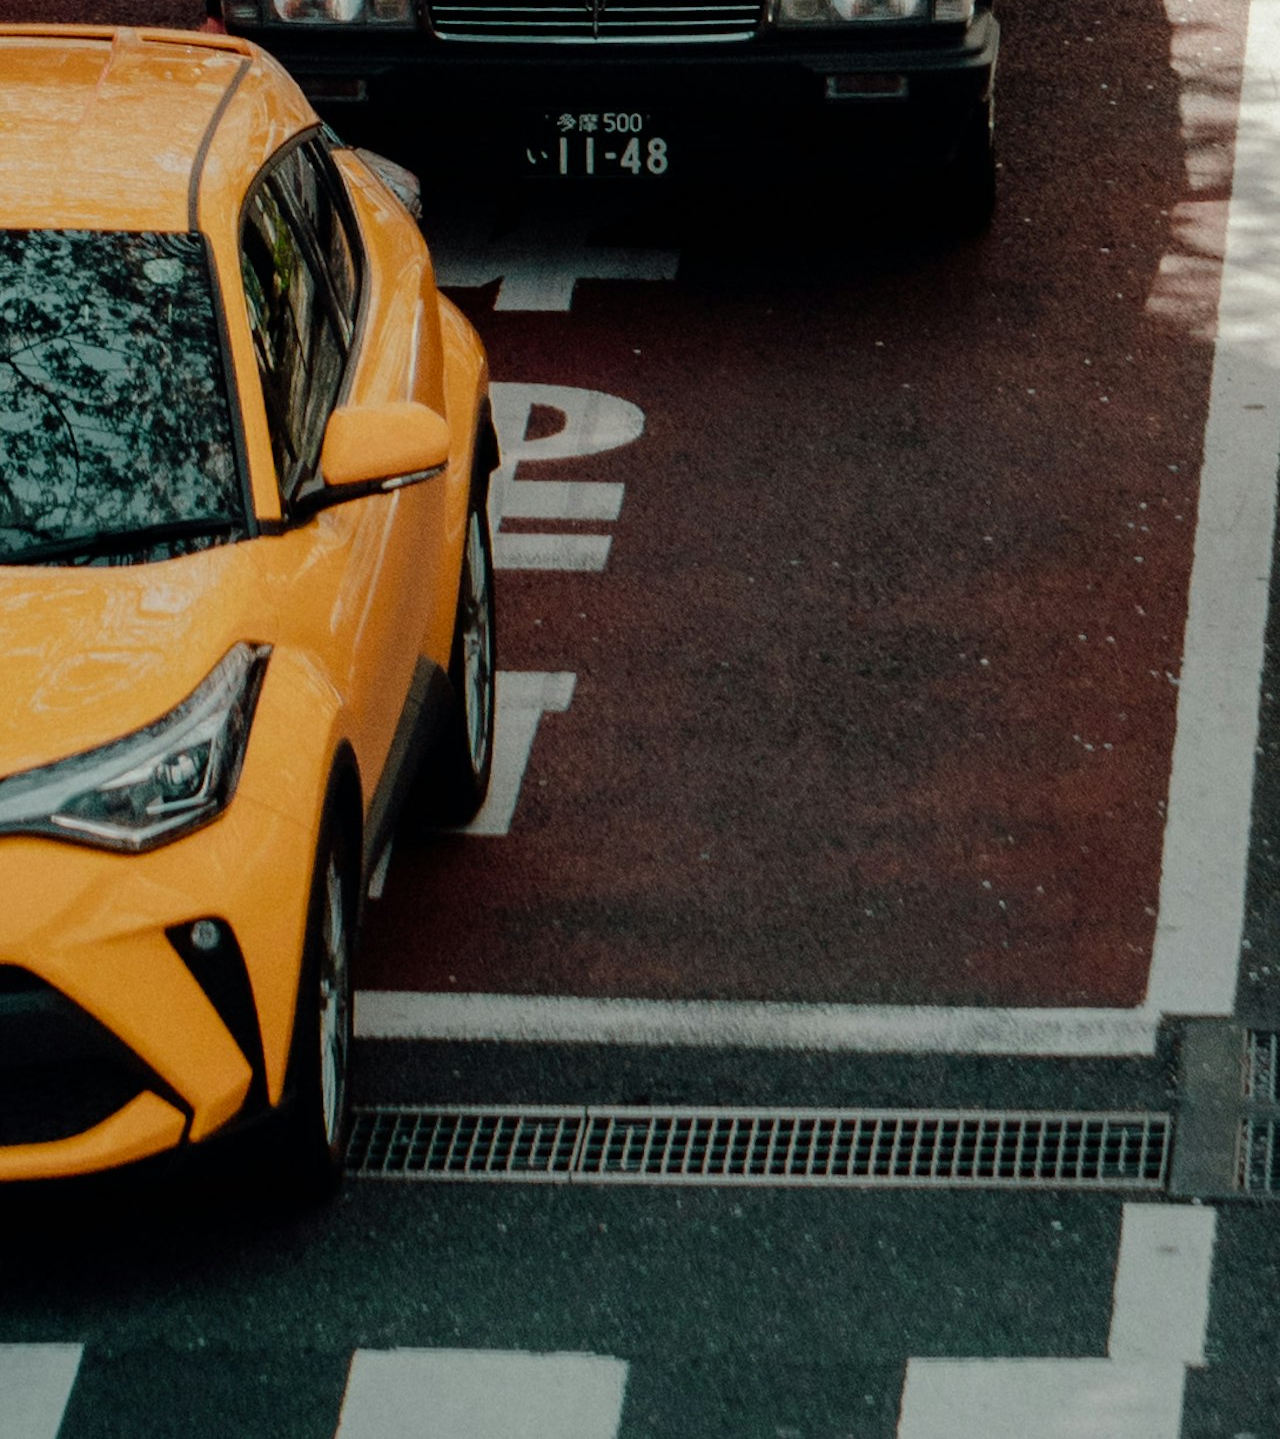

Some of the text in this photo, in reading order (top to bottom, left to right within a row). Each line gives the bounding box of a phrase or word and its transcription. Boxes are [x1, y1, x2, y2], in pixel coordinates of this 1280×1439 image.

[556, 112, 642, 132] 多摩 500
[559, 136, 668, 175] 11-48
